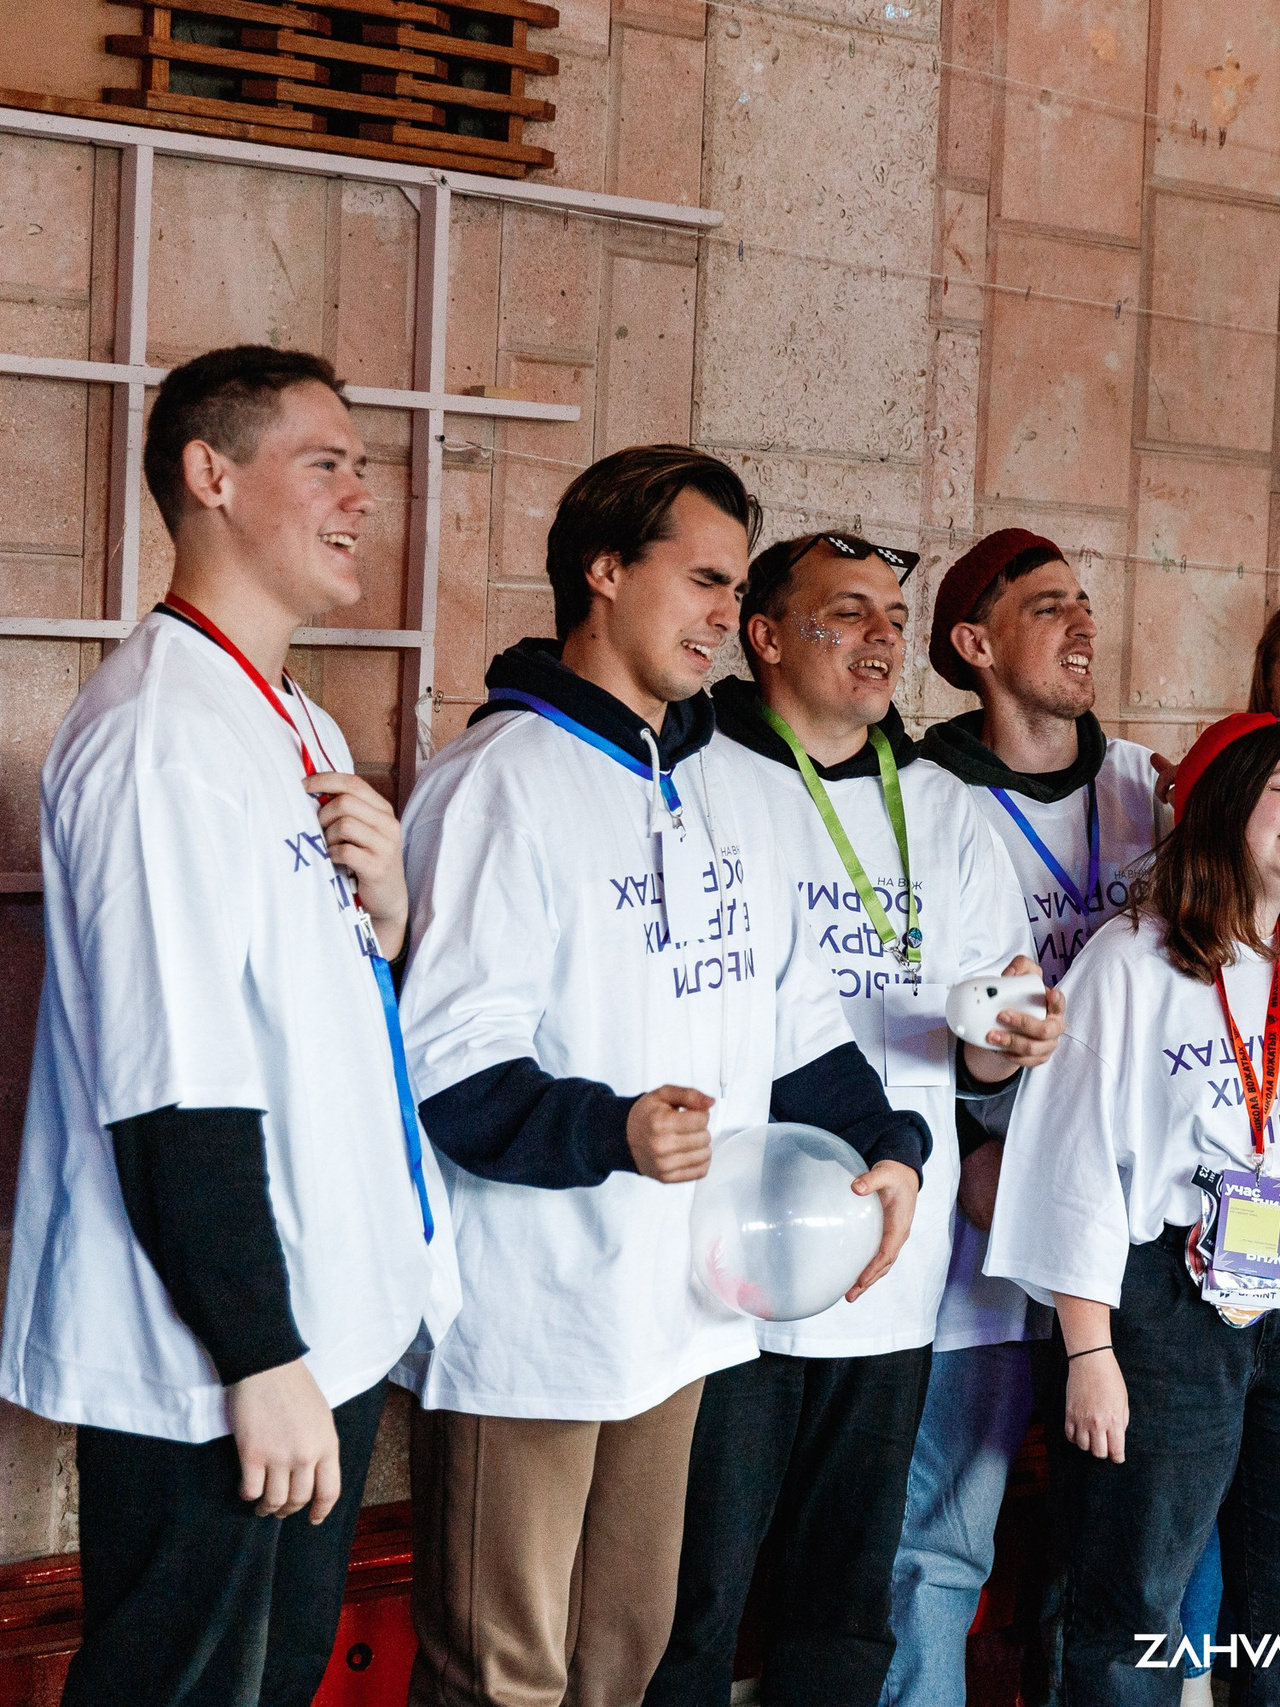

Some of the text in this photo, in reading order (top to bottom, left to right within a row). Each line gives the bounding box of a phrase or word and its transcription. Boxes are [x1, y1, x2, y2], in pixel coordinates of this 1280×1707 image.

[877, 877, 923, 890] НА ВЖ
[1266, 1032, 1278, 1078] ВОЖАТЫХ
[1250, 1096, 1262, 1132] ШКОЛА
[1225, 1183, 1261, 1199] учас
